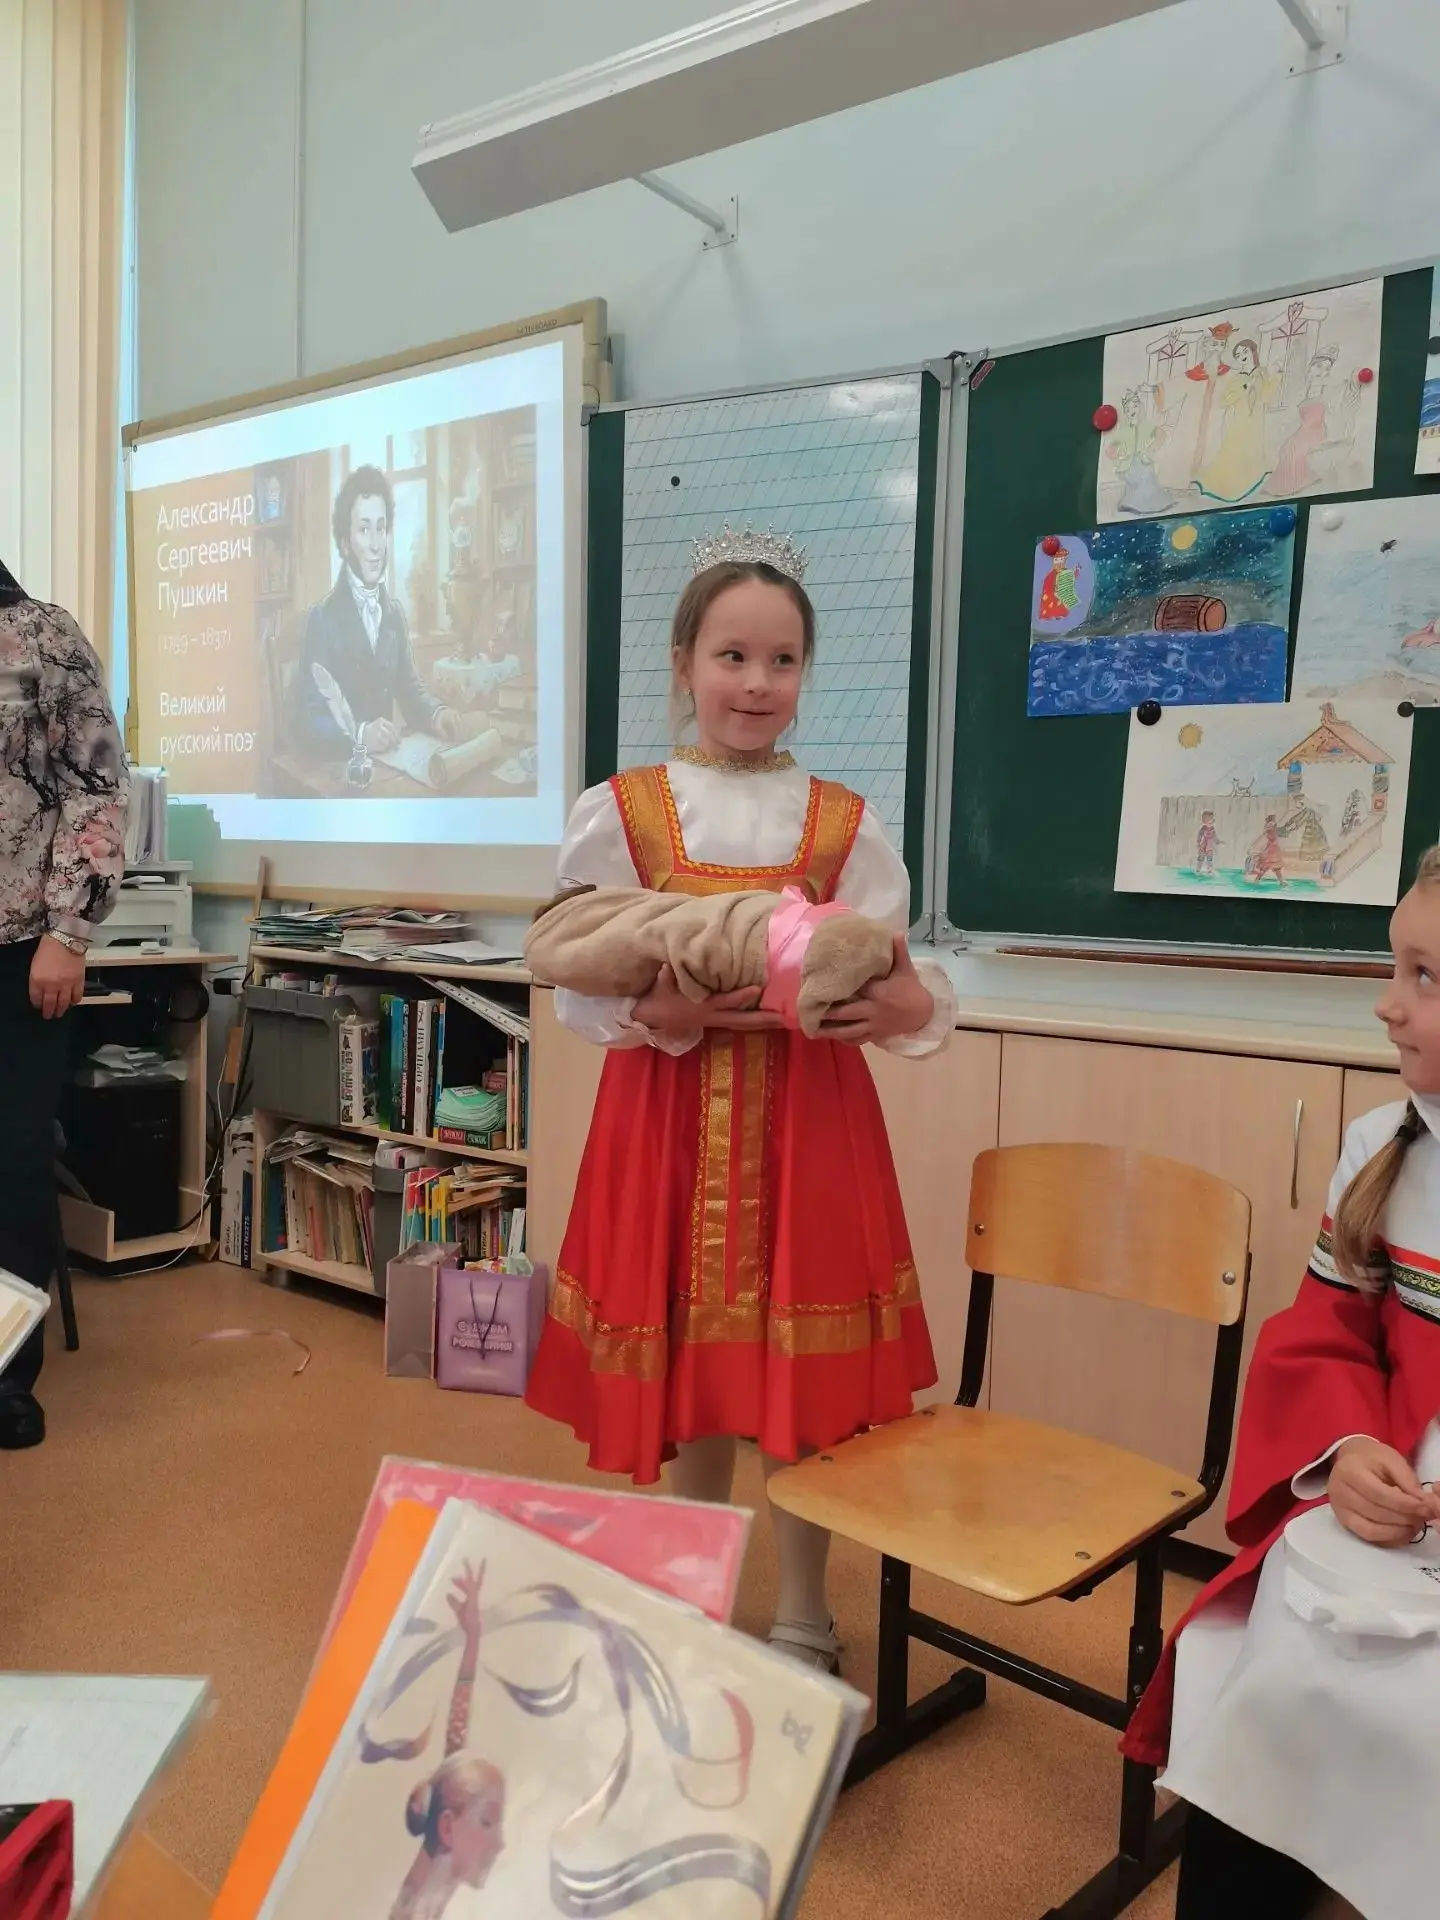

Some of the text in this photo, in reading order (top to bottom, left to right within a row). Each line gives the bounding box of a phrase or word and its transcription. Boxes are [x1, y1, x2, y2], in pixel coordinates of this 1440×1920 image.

[157, 494, 255, 533] Александр
[157, 536, 252, 577] Сергеевич
[158, 580, 228, 618] Пушкин
[160, 684, 226, 717] Великий
[160, 725, 256, 763] русский поэ
